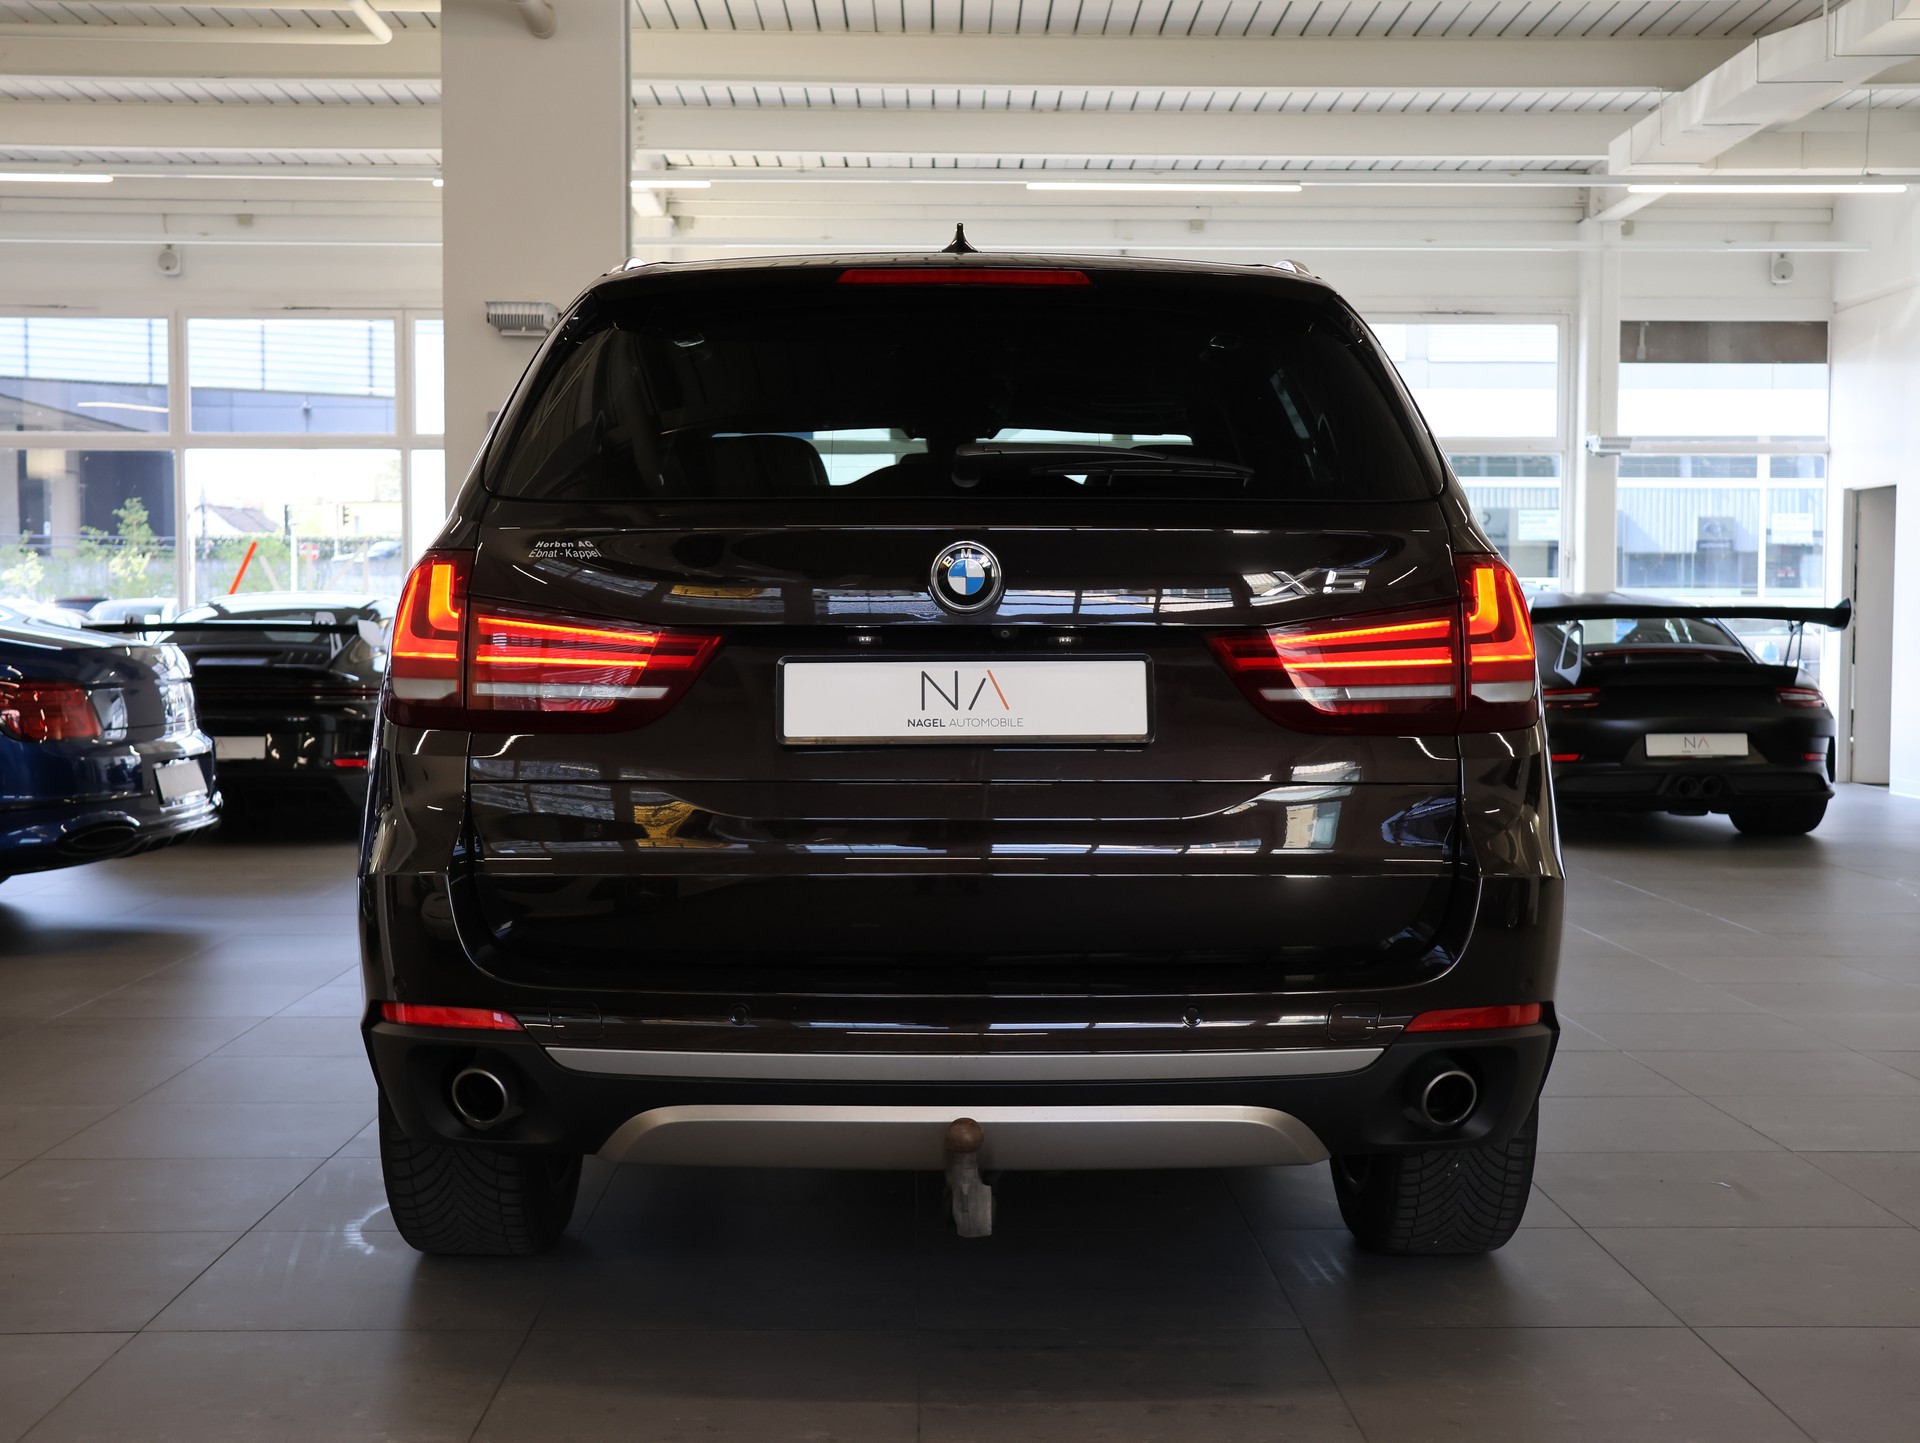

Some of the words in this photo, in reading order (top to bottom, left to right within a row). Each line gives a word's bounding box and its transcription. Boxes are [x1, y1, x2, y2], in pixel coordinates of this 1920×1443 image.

[942, 549, 991, 568] BMW
[1261, 568, 1370, 596] X5
[907, 718, 946, 728] NAGEL
[948, 718, 1024, 728] AUTOMOBILE
